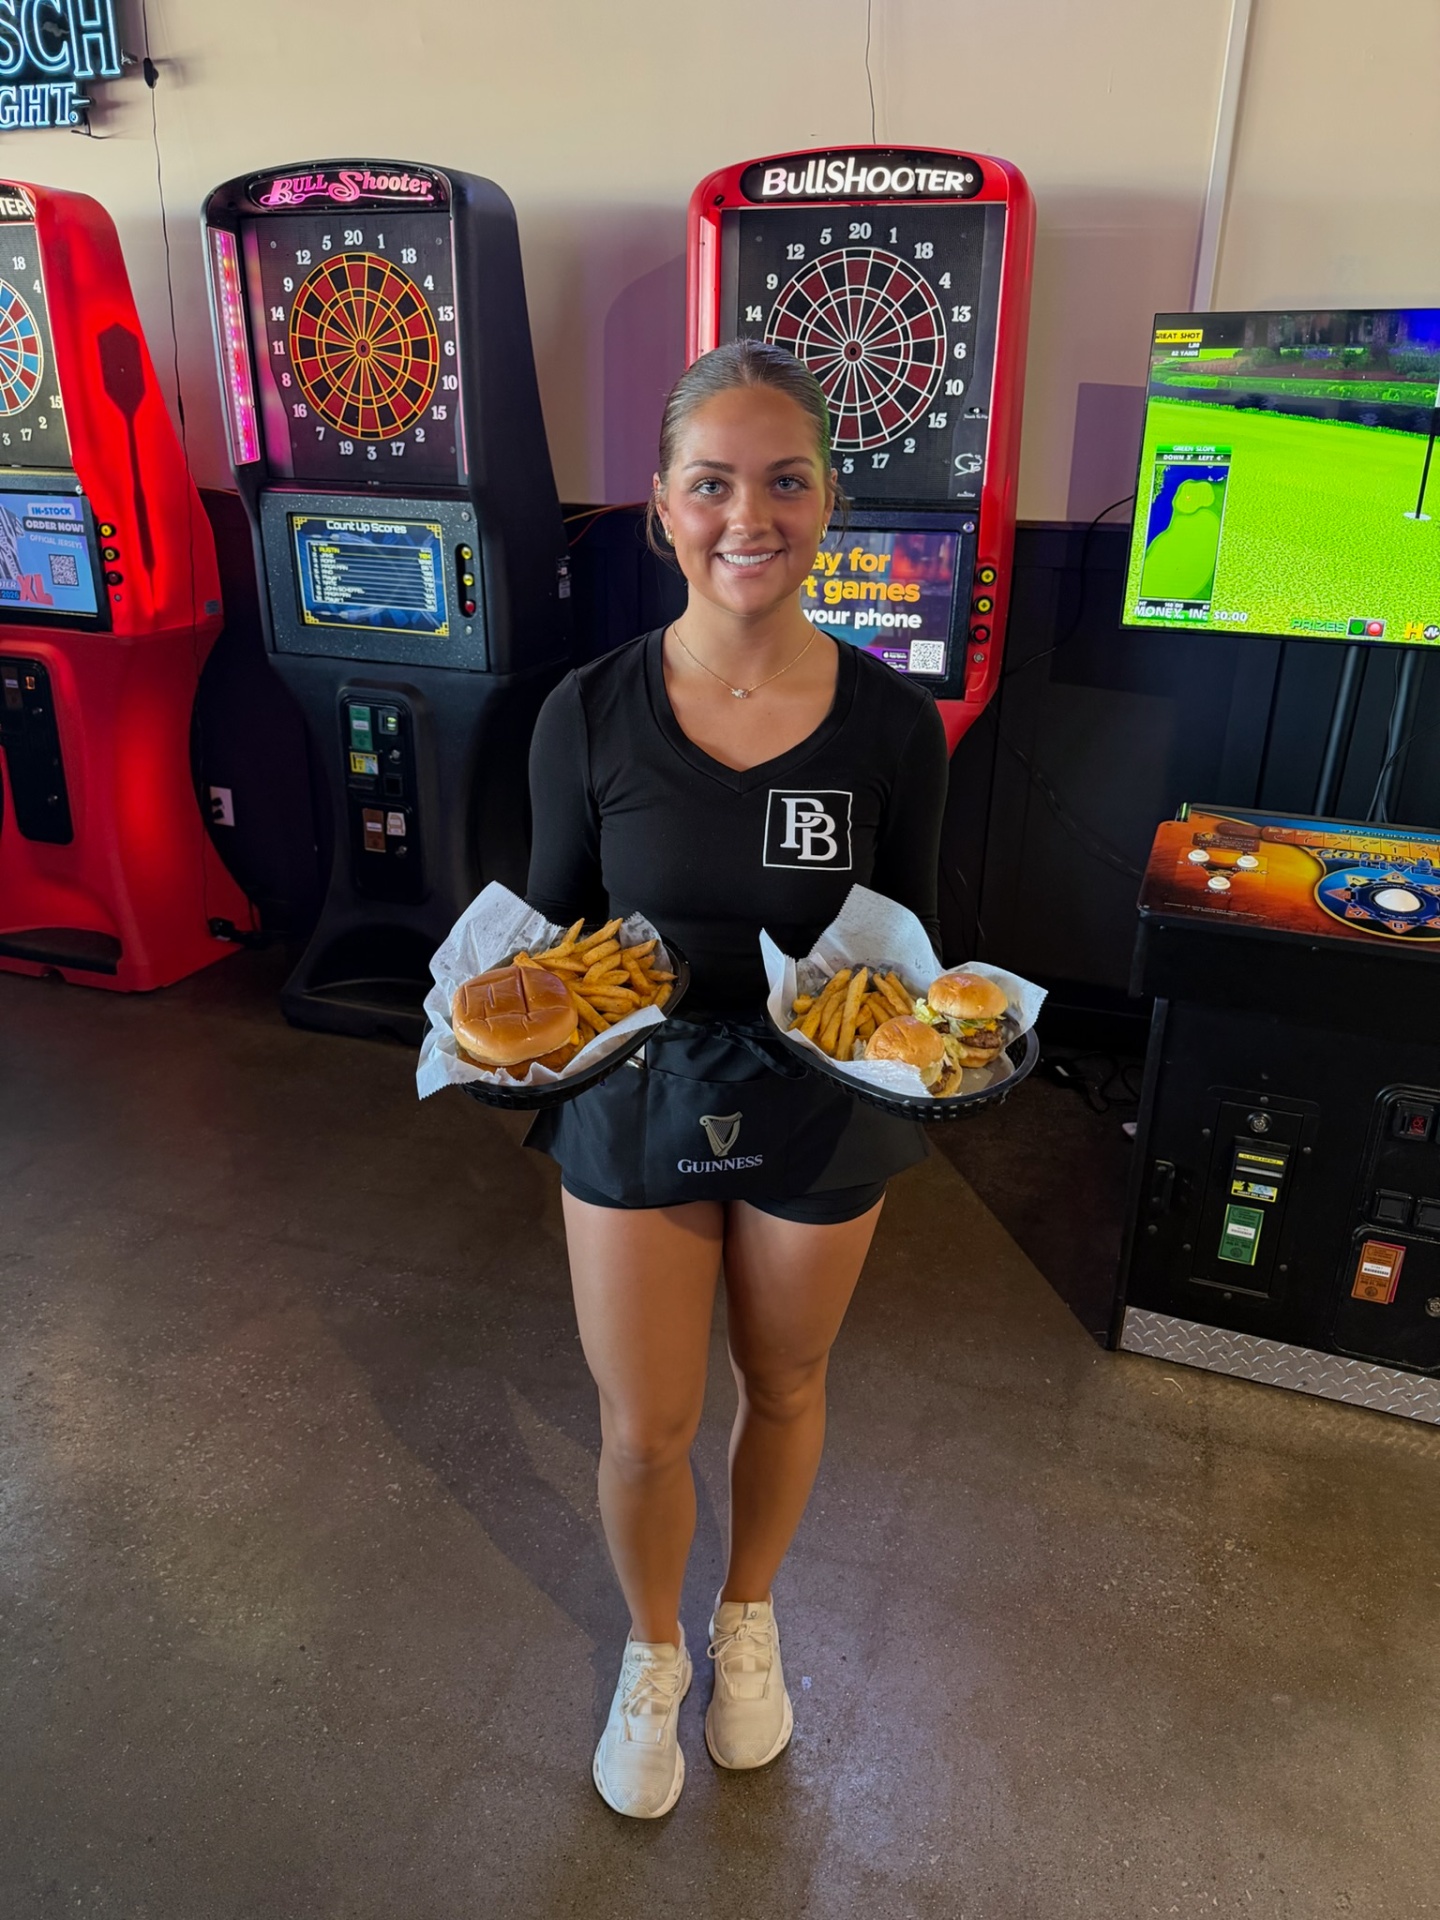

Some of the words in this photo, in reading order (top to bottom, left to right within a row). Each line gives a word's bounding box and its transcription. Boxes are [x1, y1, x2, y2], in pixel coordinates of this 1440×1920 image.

[344, 230, 362, 245] 20
[820, 228, 831, 244] 5
[849, 223, 871, 239] 20
[890, 227, 897, 243] 1
[322, 235, 331, 250] 5
[378, 234, 385, 248] 1
[296, 250, 311, 264] 12
[401, 248, 417, 263] 18
[787, 244, 805, 259] 12
[915, 242, 933, 259] 18
[12, 256, 26, 270] 18
[33, 280, 41, 293] 4
[284, 277, 293, 292] 9
[424, 275, 434, 290] 4
[767, 274, 778, 289] 9
[939, 273, 951, 288] 4
[271, 307, 284, 321] 14
[438, 306, 455, 321] 13
[746, 306, 762, 321] 14
[952, 306, 971, 322] 13
[273, 341, 285, 354] 11
[445, 341, 455, 356] 6
[954, 343, 966, 359] 6
[282, 373, 291, 387] 8
[442, 375, 457, 390] 10
[945, 379, 964, 395] 10
[293, 404, 307, 417] 16
[432, 406, 447, 420] 15
[39, 416, 47, 429] 2
[929, 413, 947, 428] 15
[3, 433, 10, 445] 3
[20, 428, 32, 441] 17
[316, 427, 325, 440] 7
[415, 428, 425, 442] 2
[339, 441, 353, 454] 19
[367, 446, 377, 460] 3
[391, 442, 405, 456] 17
[904, 438, 915, 453] 2
[842, 458, 854, 473] 3
[872, 453, 889, 468] 17
[31, 506, 72, 516] IN-STOCK
[25, 519, 57, 531] ORDER
[326, 520, 355, 531] Count
[356, 522, 370, 534] Up
[371, 522, 407, 534] Scores
[30, 534, 57, 545] OFFICIAL
[849, 547, 891, 573] for
[17, 573, 54, 606] XL
[824, 580, 920, 605] games
[802, 609, 851, 624] your
[854, 608, 922, 630] phone
[1134, 606, 1182, 618] MONEY
[1291, 619, 1347, 632] PRIZES
[677, 1154, 763, 1174] GUINNESS
